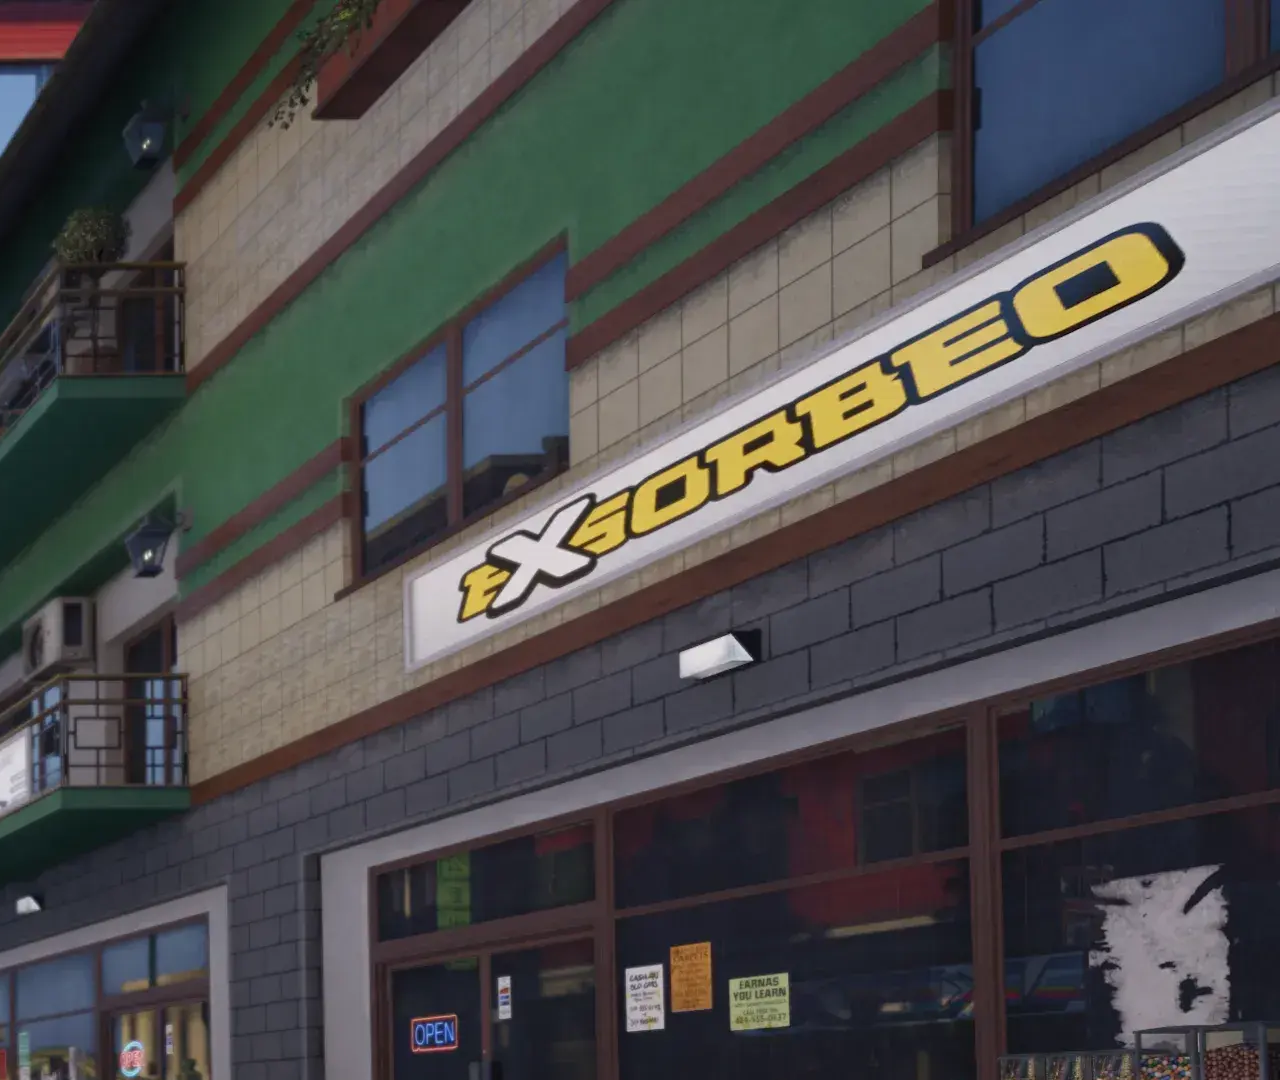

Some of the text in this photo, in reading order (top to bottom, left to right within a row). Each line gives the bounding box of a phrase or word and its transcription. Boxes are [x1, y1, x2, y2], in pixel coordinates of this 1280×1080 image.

[733, 987, 787, 1001] YOU LEARN
[414, 1021, 455, 1046] OPEN
